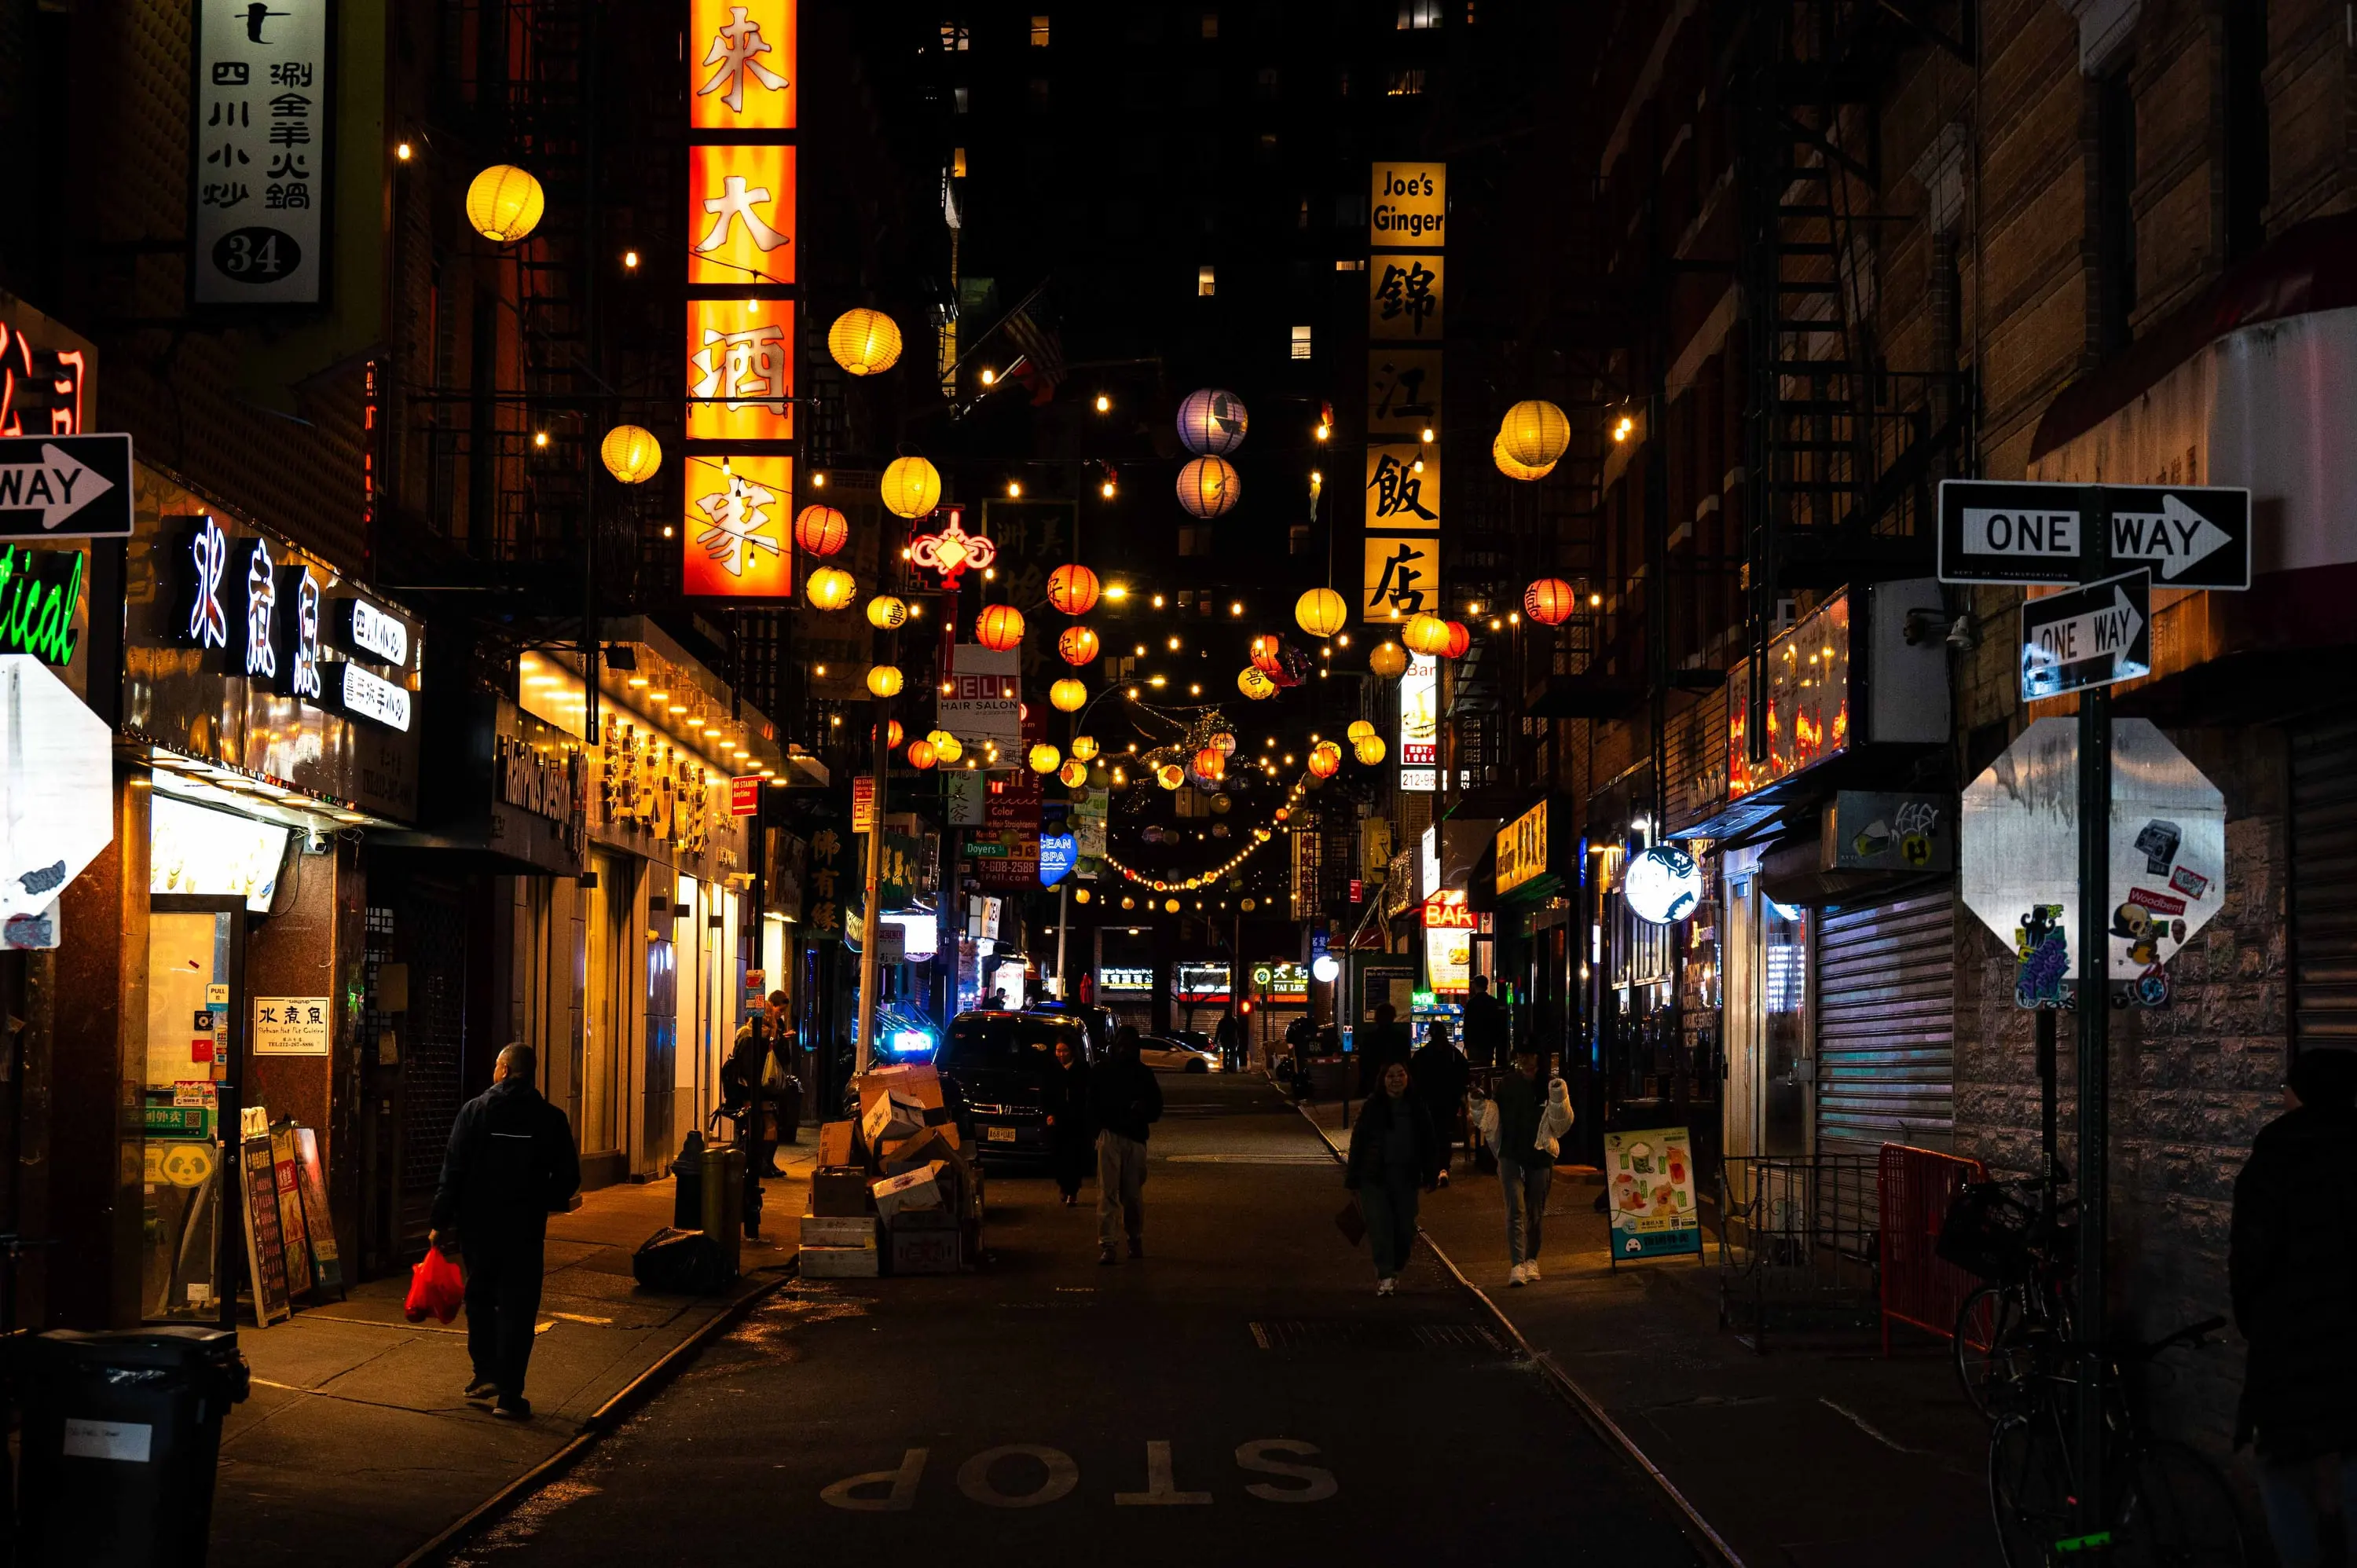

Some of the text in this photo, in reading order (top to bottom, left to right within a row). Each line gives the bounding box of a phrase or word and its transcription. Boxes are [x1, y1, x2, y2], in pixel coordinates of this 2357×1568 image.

[203, 61, 250, 209] 四川小炒
[1384, 171, 1434, 197] Joe's
[1373, 203, 1445, 237] Ginger
[228, 235, 281, 273] 34
[1367, 262, 1439, 615] 錦江飯店
[1986, 514, 2201, 556] ONE WAY
[2041, 607, 2132, 664] ONE WAY
[941, 701, 1018, 710] HAIR SALON
[542, 751, 571, 841] Design
[733, 790, 750, 799] Anytime
[992, 806, 1014, 816] Color
[1004, 819, 1038, 829] Straightening
[967, 843, 996, 855] Doyers
[1041, 852, 1065, 862] SPA
[2131, 890, 2184, 914] Woodbent
[1426, 904, 1473, 926] BAR
[258, 1006, 324, 1025] 水煮魚
[819, 1438, 1339, 1511] STOP
